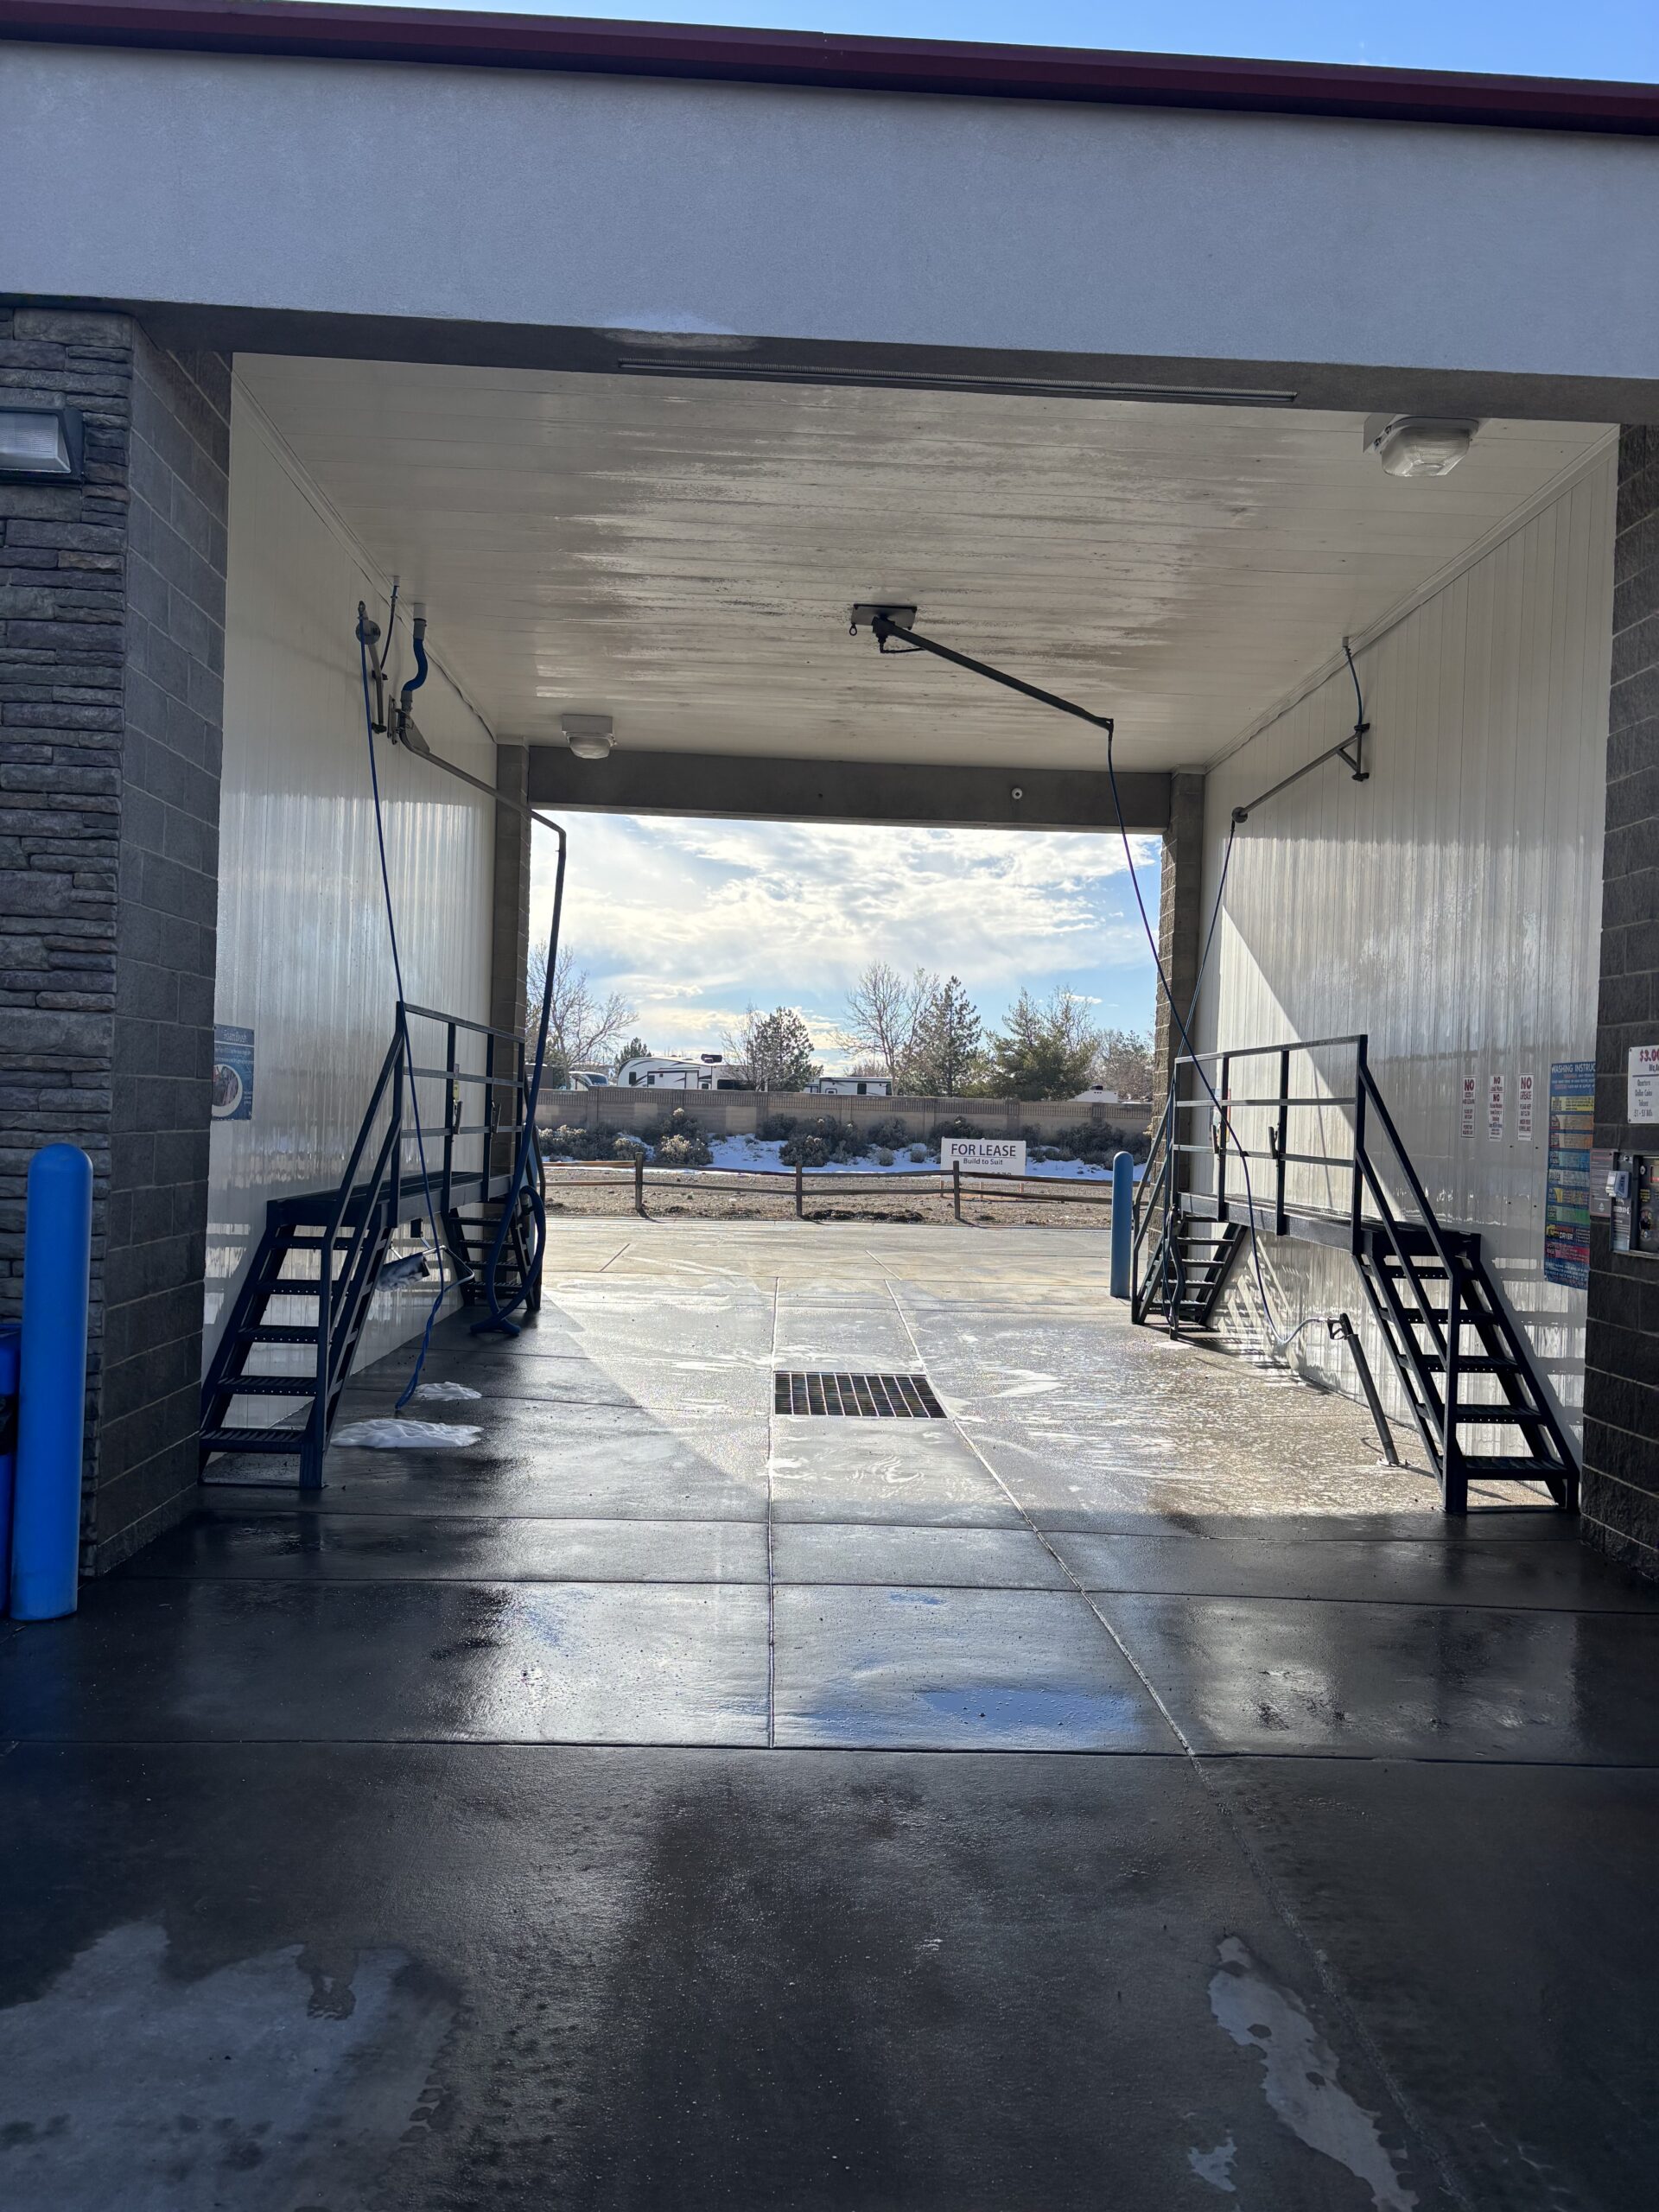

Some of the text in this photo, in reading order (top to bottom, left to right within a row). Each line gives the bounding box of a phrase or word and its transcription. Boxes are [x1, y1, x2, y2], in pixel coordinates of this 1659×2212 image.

[1552, 1064, 1573, 1073] WASHING
[1464, 1079, 1474, 1090] NO
[1521, 1077, 1532, 1090] NO
[951, 1143, 1016, 1156] FOR LEASE
[1559, 1231, 1573, 1241] DRYER
